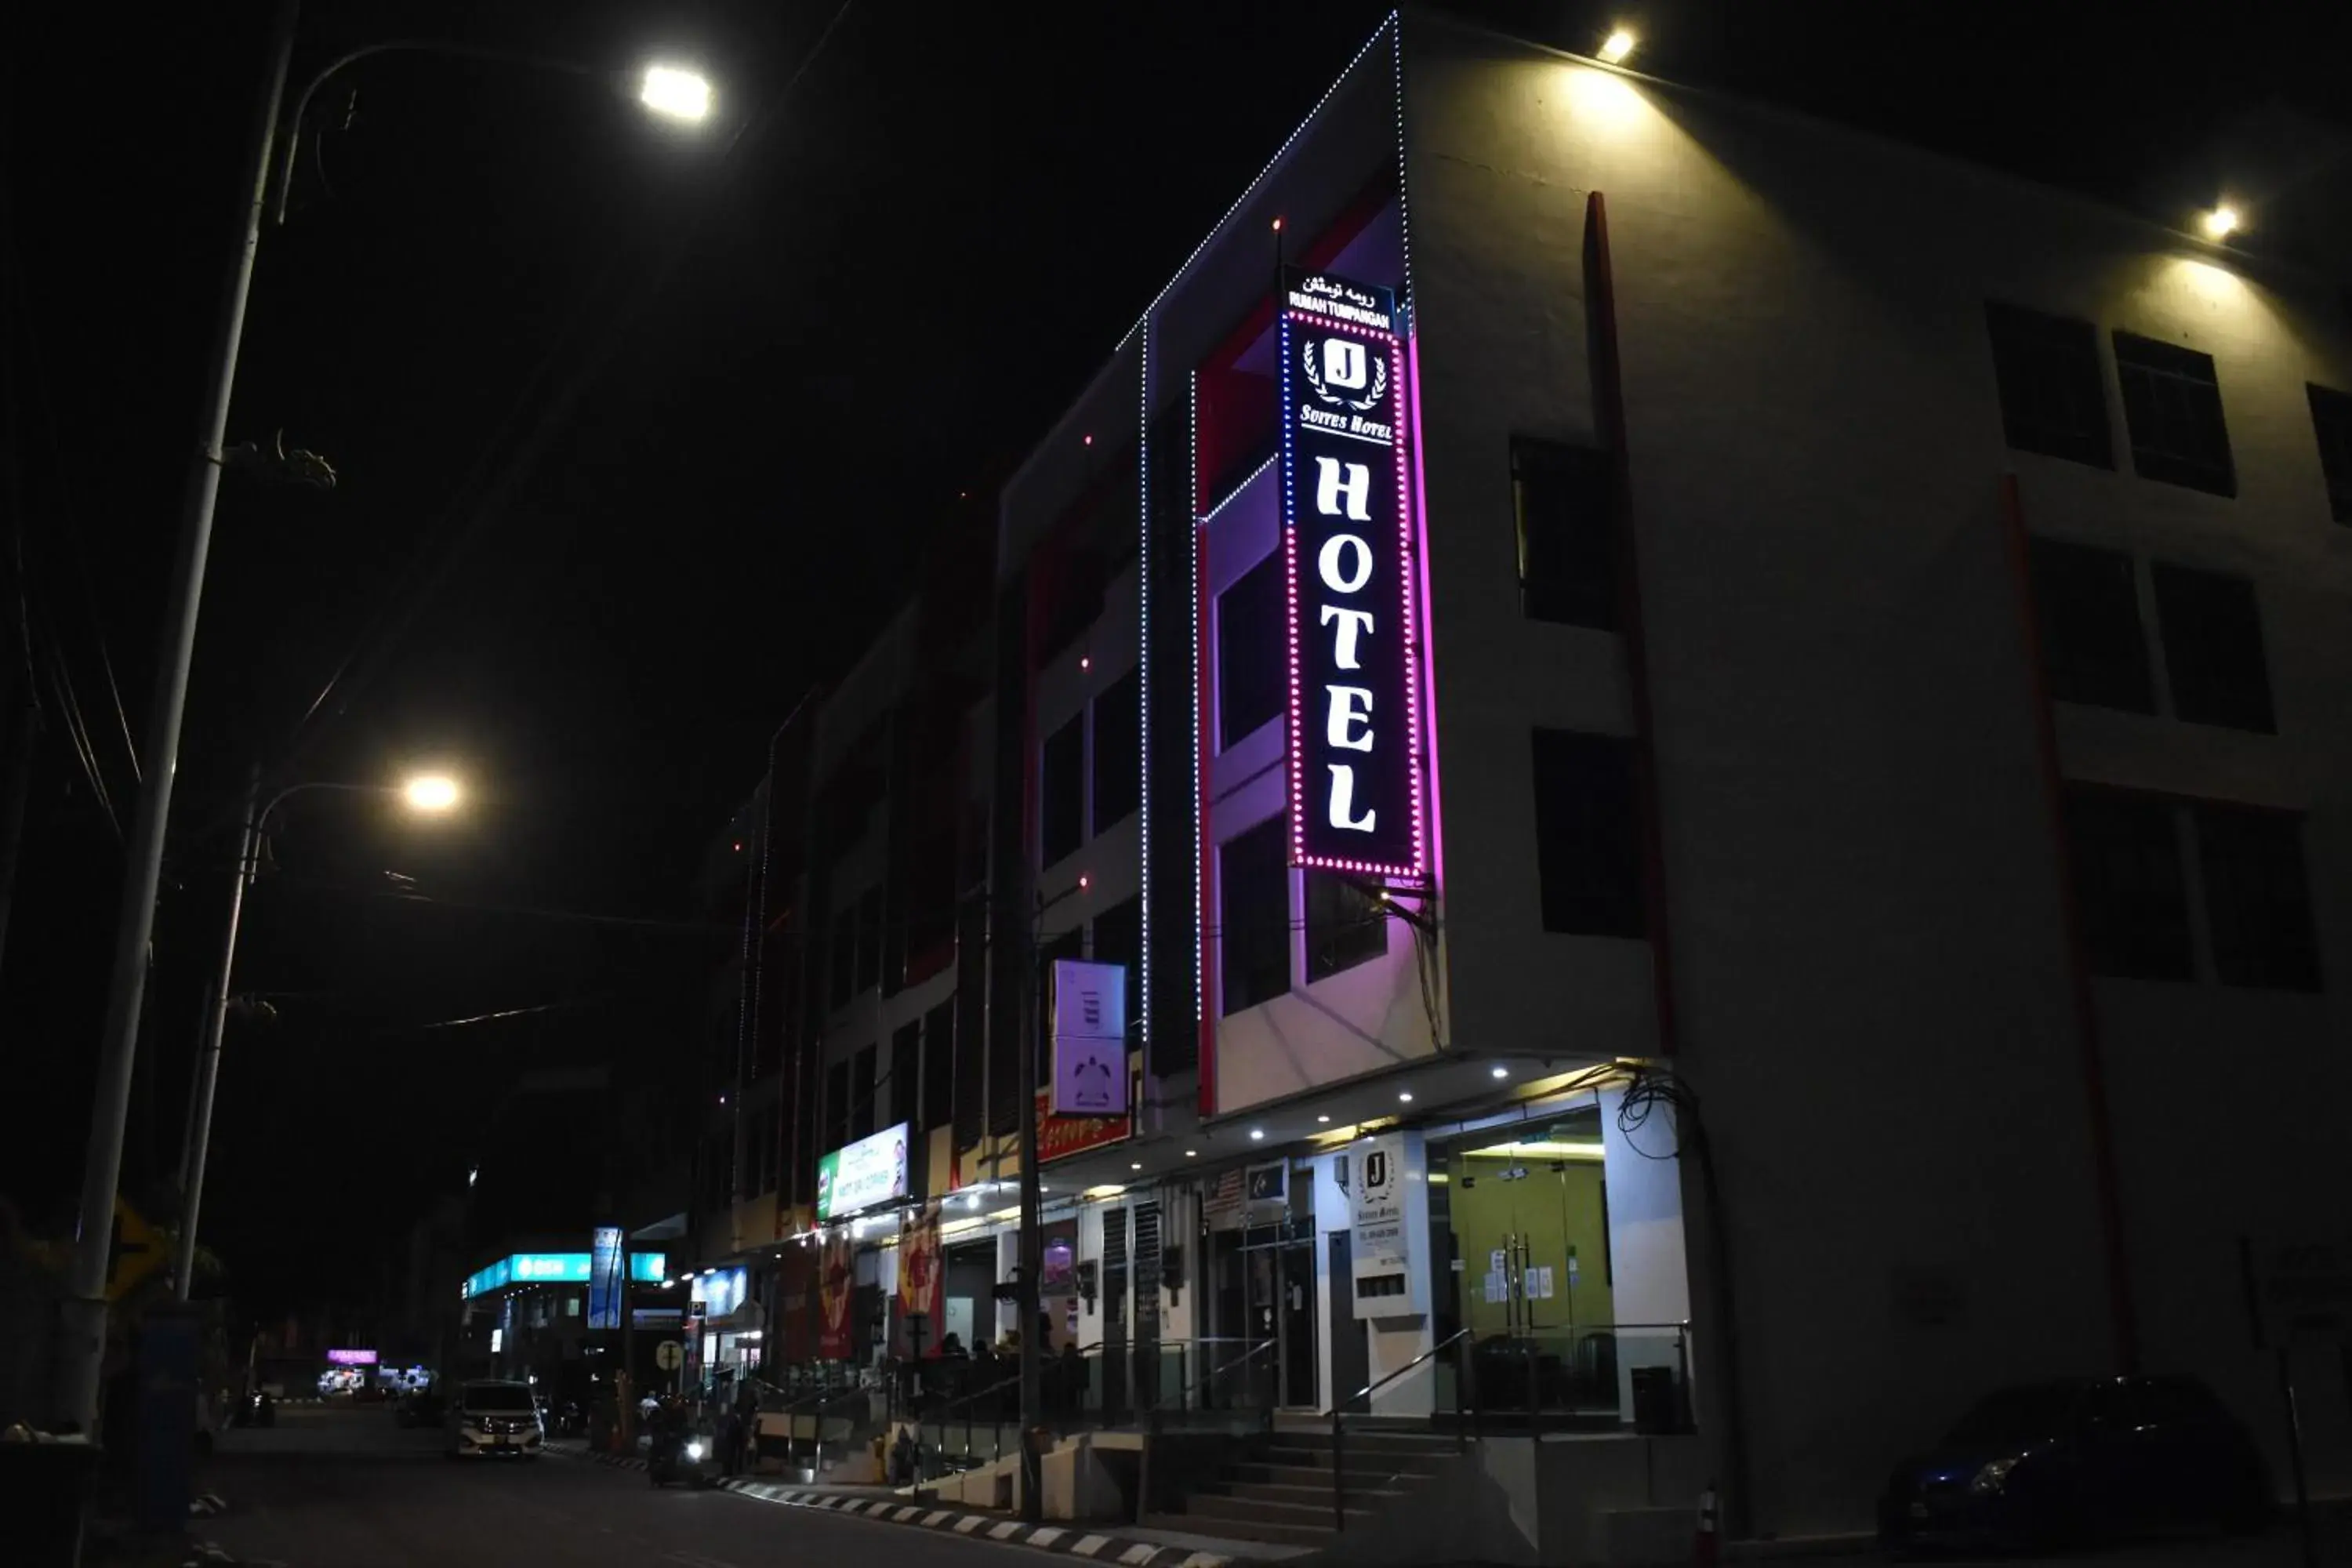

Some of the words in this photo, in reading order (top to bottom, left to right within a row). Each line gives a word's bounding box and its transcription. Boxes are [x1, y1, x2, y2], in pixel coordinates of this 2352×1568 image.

[1289, 291, 1327, 315] RUMAH
[1327, 299, 1391, 330] TUMPANGAN
[1335, 347, 1352, 380] J
[1350, 414, 1393, 440] HOTEL
[1315, 455, 1376, 833] HOTEL
